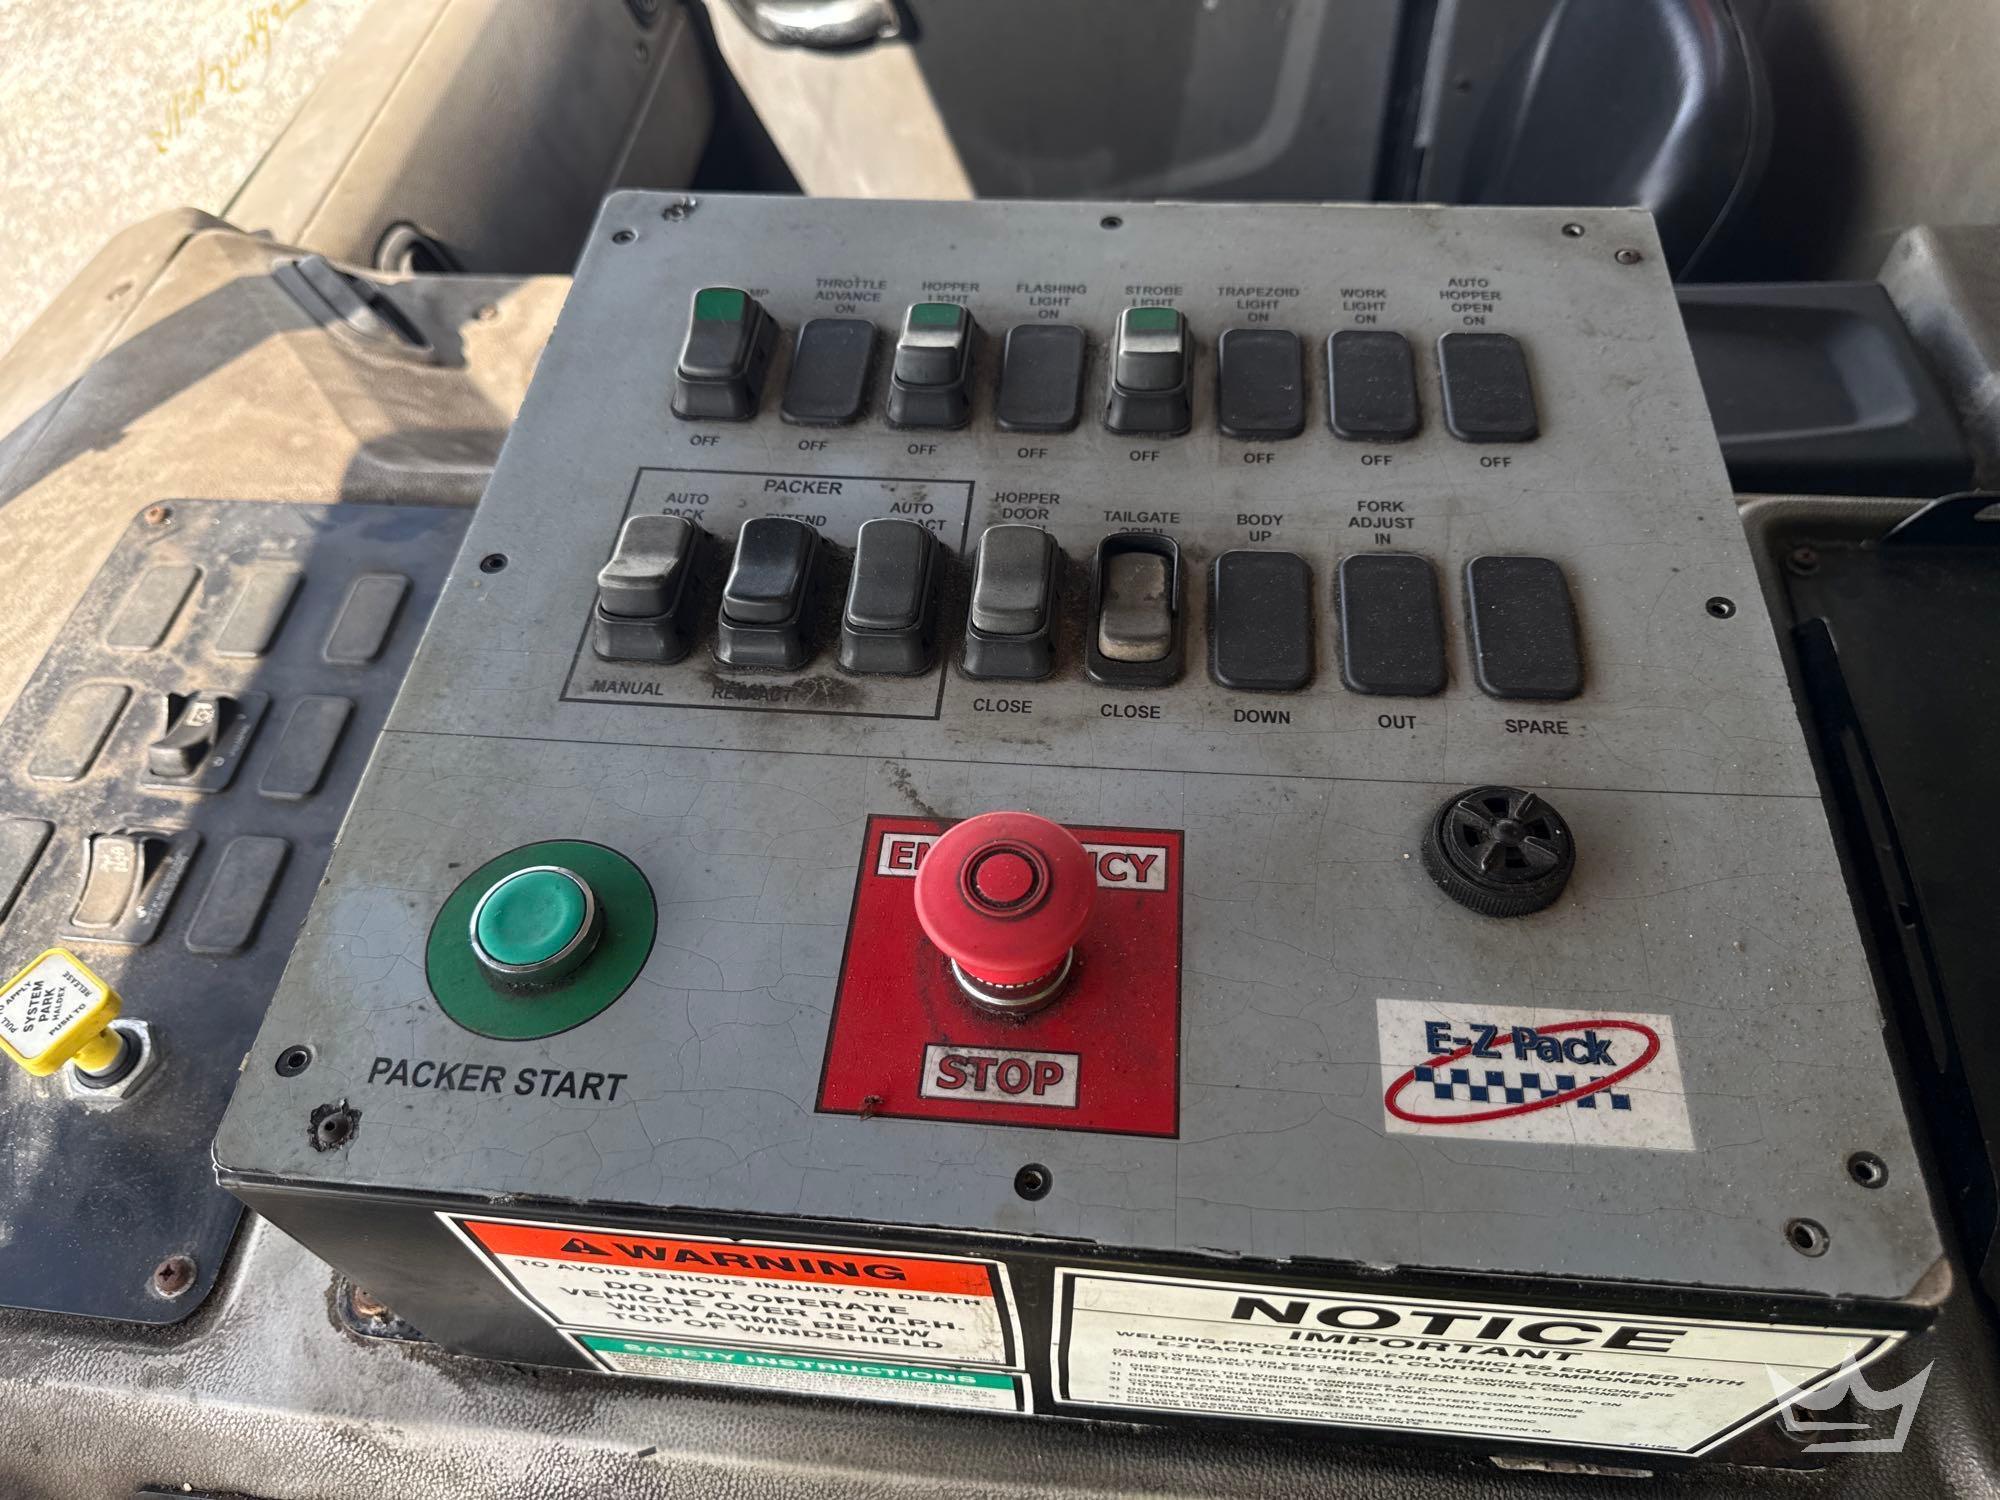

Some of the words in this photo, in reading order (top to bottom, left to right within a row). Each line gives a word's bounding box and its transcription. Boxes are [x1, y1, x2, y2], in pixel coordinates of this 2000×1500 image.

[816, 278, 887, 290] THROTTLE
[922, 281, 980, 292] HOPPER
[1016, 283, 1086, 296] FLASHING
[1448, 278, 1489, 288] AUTO
[815, 291, 881, 303] ADVANCE
[1125, 286, 1183, 296] STROBE
[1218, 287, 1300, 298] TRAPEZOID
[1341, 289, 1387, 299] WORK
[1440, 290, 1502, 301] HOPPER
[928, 294, 968, 304] LIGHT
[1030, 296, 1070, 308] LIGHT
[1132, 299, 1174, 307] LIGHT
[1237, 300, 1280, 310] LIGHT
[835, 304, 856, 314] ON
[1343, 302, 1386, 312] LIGHT
[1451, 303, 1493, 313] OPEN
[1038, 309, 1059, 319] ON
[1247, 312, 1269, 322] ON
[1355, 314, 1377, 324] ON
[1462, 316, 1485, 326] ON
[690, 435, 720, 447] OFF
[798, 439, 828, 452] OFF
[907, 443, 938, 456] OFF
[1017, 447, 1048, 460] OFF
[1130, 450, 1160, 462] OFF
[1244, 452, 1275, 465] OFF
[1361, 454, 1393, 467] OFF
[1480, 456, 1512, 468] OFF
[764, 479, 843, 496] PACKER
[665, 492, 710, 505] AUTO
[995, 492, 1060, 505] HOPPER
[890, 502, 934, 515] AUTO
[1357, 500, 1404, 513] FORK
[1002, 508, 1050, 520] DOOR
[1103, 510, 1180, 524] TAILGATE
[1236, 513, 1283, 526] BODY
[1348, 516, 1415, 530] ADJUST
[1249, 530, 1272, 543] UP
[1375, 532, 1392, 545] IN
[590, 679, 665, 697] MANUAL
[973, 698, 1033, 715] CLOSE
[1100, 703, 1161, 720] CLOSE
[1233, 708, 1291, 725] DOWN
[1378, 714, 1417, 731] OUT
[1505, 718, 1569, 736] SPARE
[62, 971, 93, 998] RELEASE
[6, 981, 31, 1005] APPLY
[23, 980, 45, 1033] SYSTEM
[39, 988, 56, 1022] PARK
[73, 1003, 87, 1014] TO
[49, 1014, 74, 1036] PUSH
[1425, 1020, 1502, 1060] E-Z
[1510, 1025, 1617, 1067] Pack
[368, 1056, 507, 1094] PACKER
[514, 1067, 628, 1103] START
[936, 1054, 1064, 1096] STOP
[612, 1242, 907, 1282] WARNING
[515, 1258, 549, 1268] TO
[557, 1263, 630, 1276] AVOID
[638, 1271, 747, 1287] SERIOUS
[755, 1281, 844, 1295] INJURY
[854, 1290, 889, 1299] OR
[898, 1293, 981, 1306] DEATH
[604, 1280, 653, 1293] DO
[664, 1286, 735, 1300] NOT
[750, 1294, 909, 1315] OPERATE
[559, 1286, 704, 1308] VEHICLE
[714, 1302, 808, 1318] OVER
[821, 1312, 857, 1321] 15
[868, 1315, 965, 1331] M.P.H.
[605, 1301, 693, 1317] WITH
[705, 1311, 801, 1327] ARMS
[813, 1321, 930, 1339] BELOW
[1230, 1296, 1688, 1353] NOTICE
[606, 1312, 673, 1324] TOP
[684, 1319, 726, 1330] OF
[736, 1323, 943, 1349] WINDSHIELD
[1289, 1331, 1583, 1361] IMPORTANT
[623, 1343, 735, 1361] SAFETY
[745, 1355, 977, 1385] INSTRUCTIONS
[1116, 1330, 1215, 1344] WELDING
[1222, 1339, 1376, 1357] PROCEDURES
[1384, 1352, 1431, 1361] FOR
[1440, 1356, 1551, 1371] VEHICLES
[1559, 1366, 1678, 1381] EQUIPPED
[1686, 1376, 1744, 1386] WITH
[1156, 1340, 1190, 1349] E-Z
[1196, 1343, 1253, 1353] PACK
[1261, 1349, 1398, 1365] ELECTRICAL
[1406, 1360, 1517, 1374] CONTROL
[1525, 1370, 1687, 1388] COMPONENTS
[1171, 1352, 1212, 1360] WELD
[1281, 1361, 1345, 1371] VEHICLE
[1350, 1366, 1393, 1375] UNTIL
